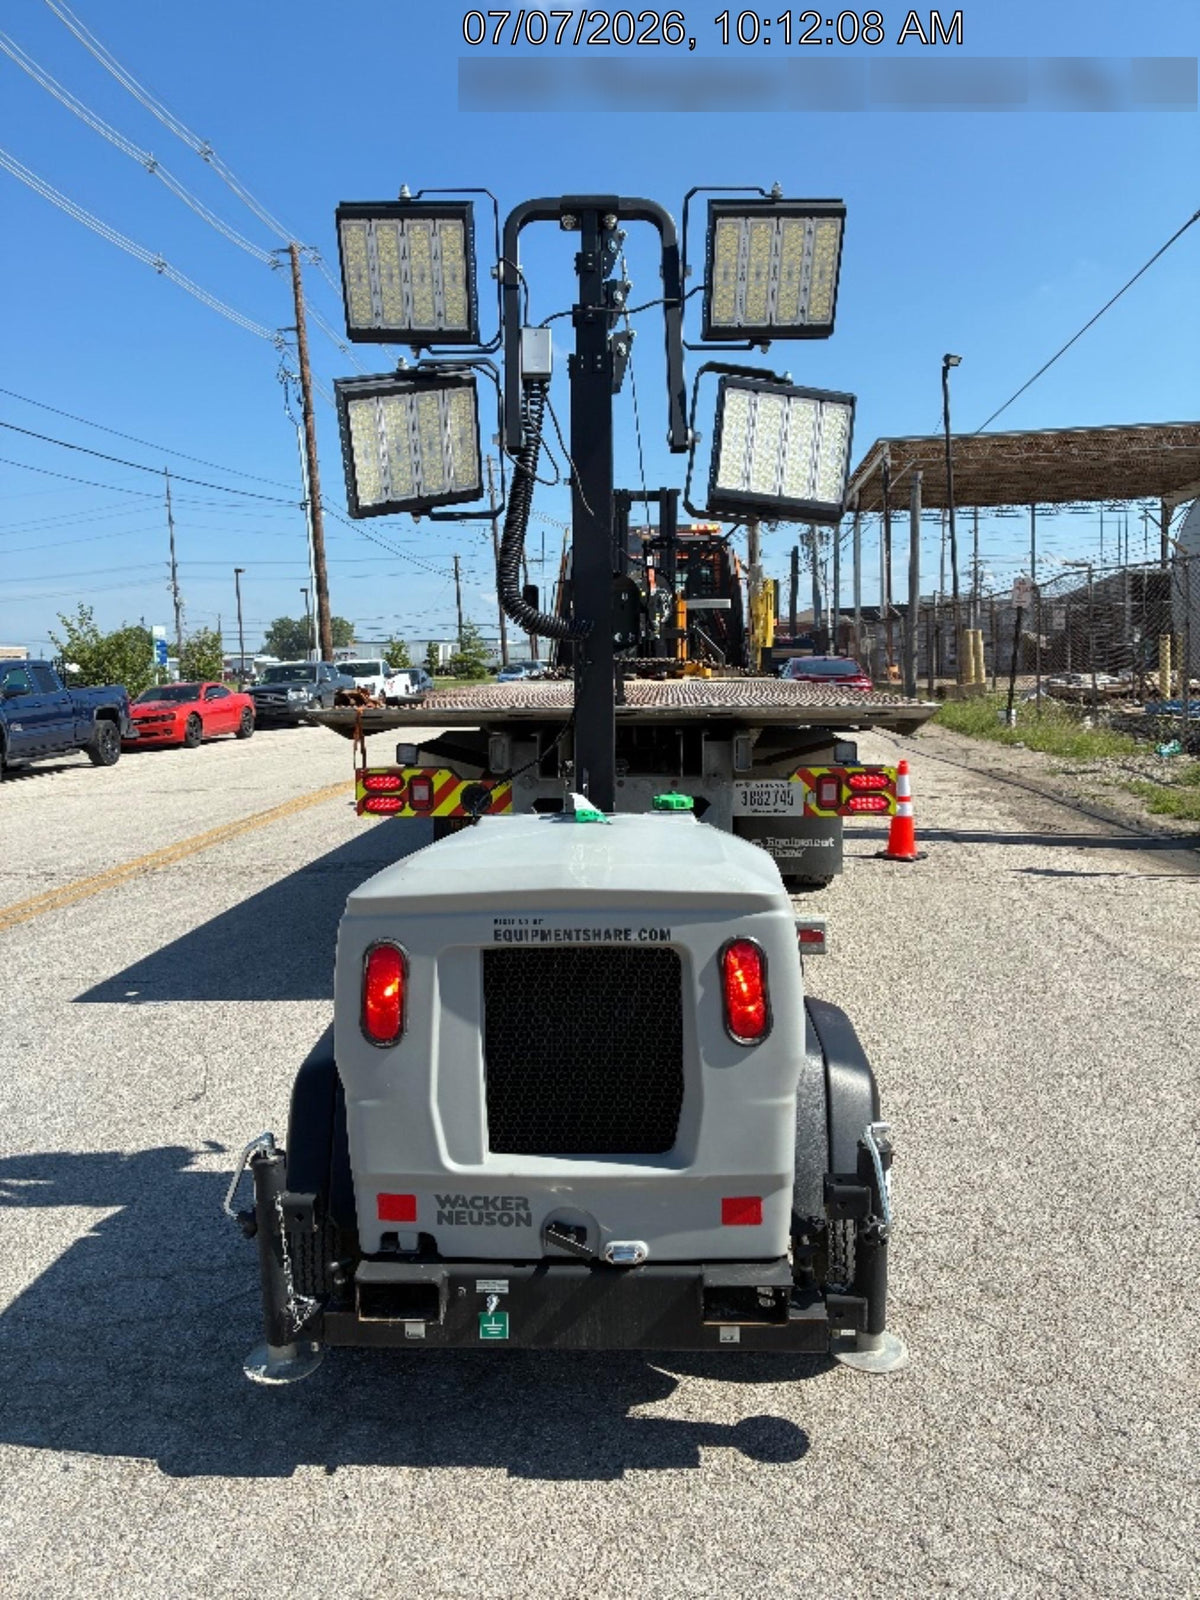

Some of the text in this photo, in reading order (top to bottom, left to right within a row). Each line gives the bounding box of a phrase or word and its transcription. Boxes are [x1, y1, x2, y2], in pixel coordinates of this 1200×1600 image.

[493, 928, 672, 942] EQUIPMENTSHARE.COM
[433, 1193, 530, 1211] WACKER
[436, 1210, 533, 1228] NEUSON
